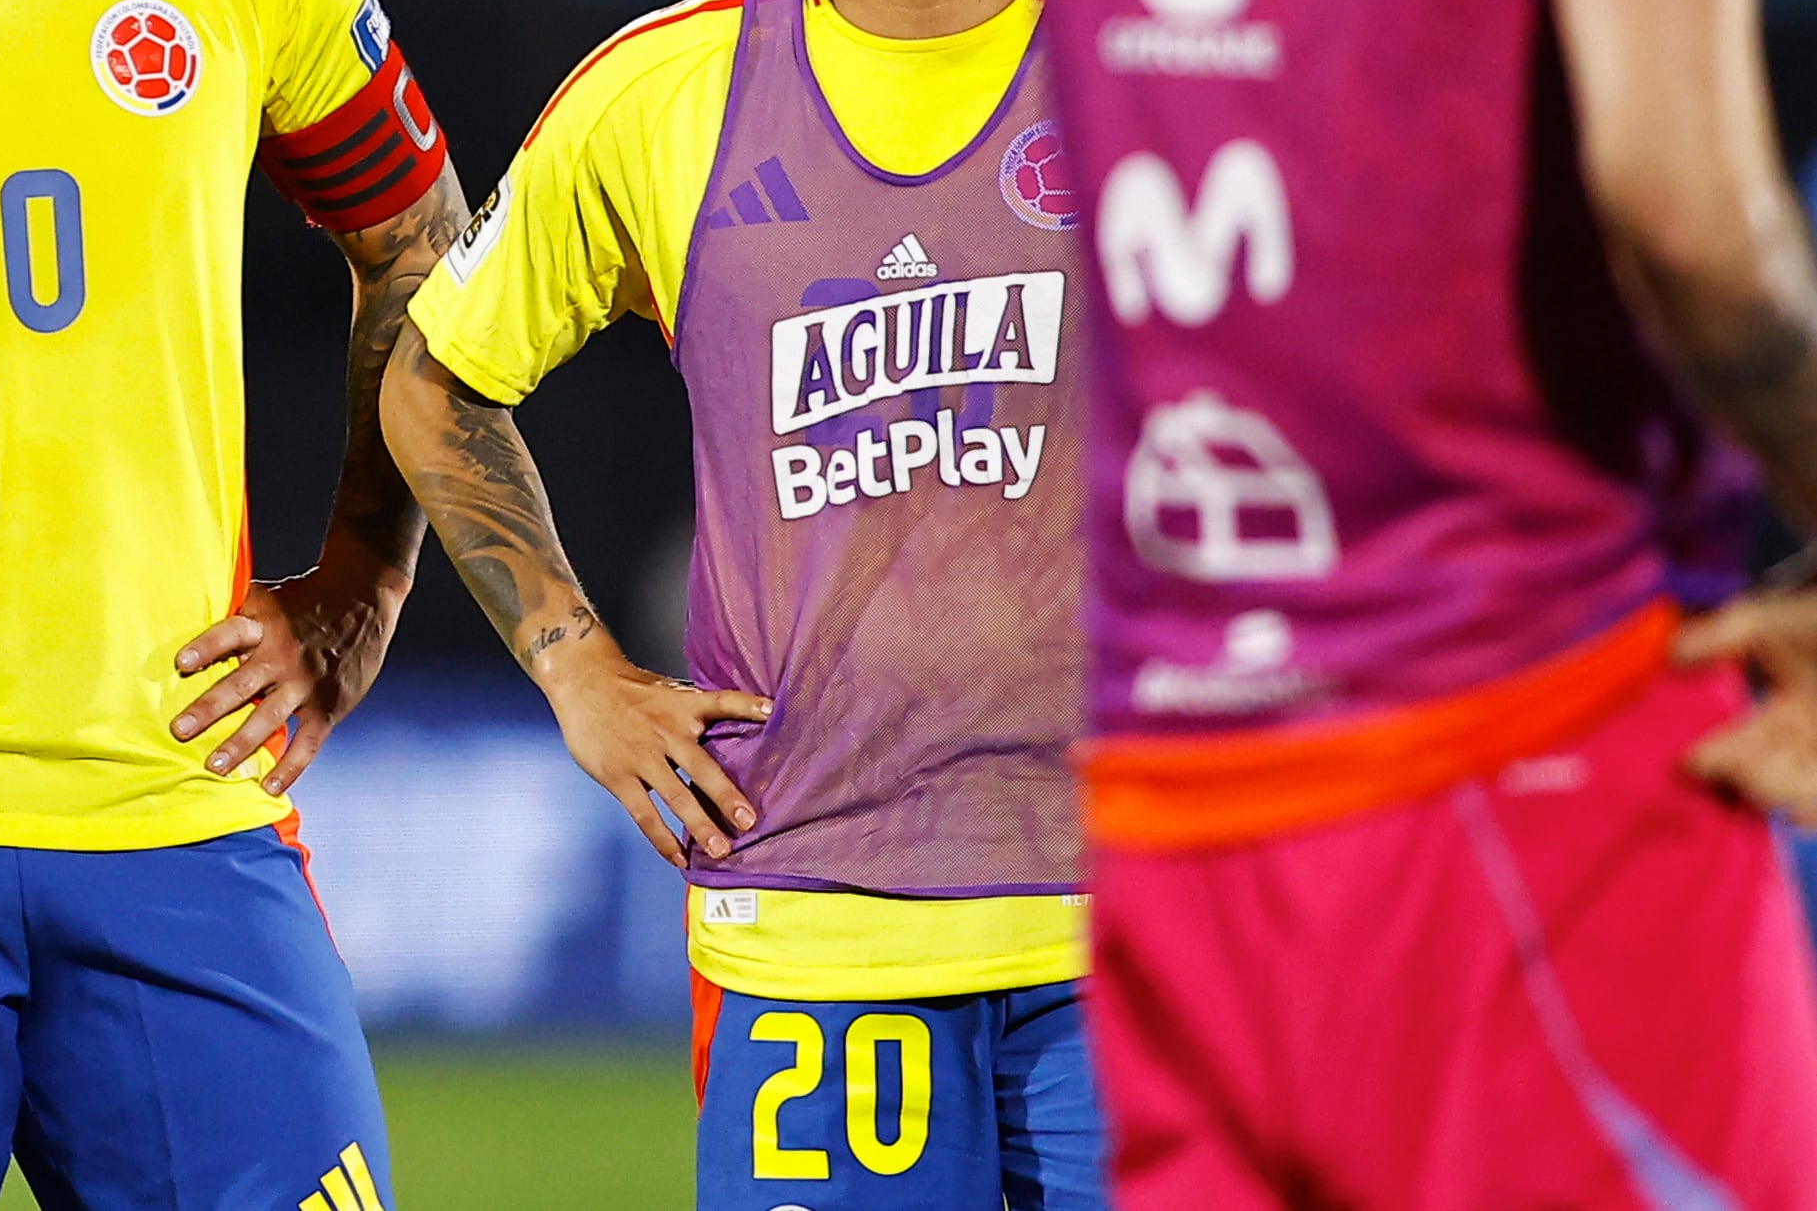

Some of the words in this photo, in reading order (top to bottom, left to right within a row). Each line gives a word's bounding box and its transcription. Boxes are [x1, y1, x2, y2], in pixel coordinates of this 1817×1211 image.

[876, 259, 938, 280] adidas
[791, 284, 1035, 419] AGUILA
[771, 408, 1047, 520] BetPlay
[749, 1011, 932, 1180] 20
